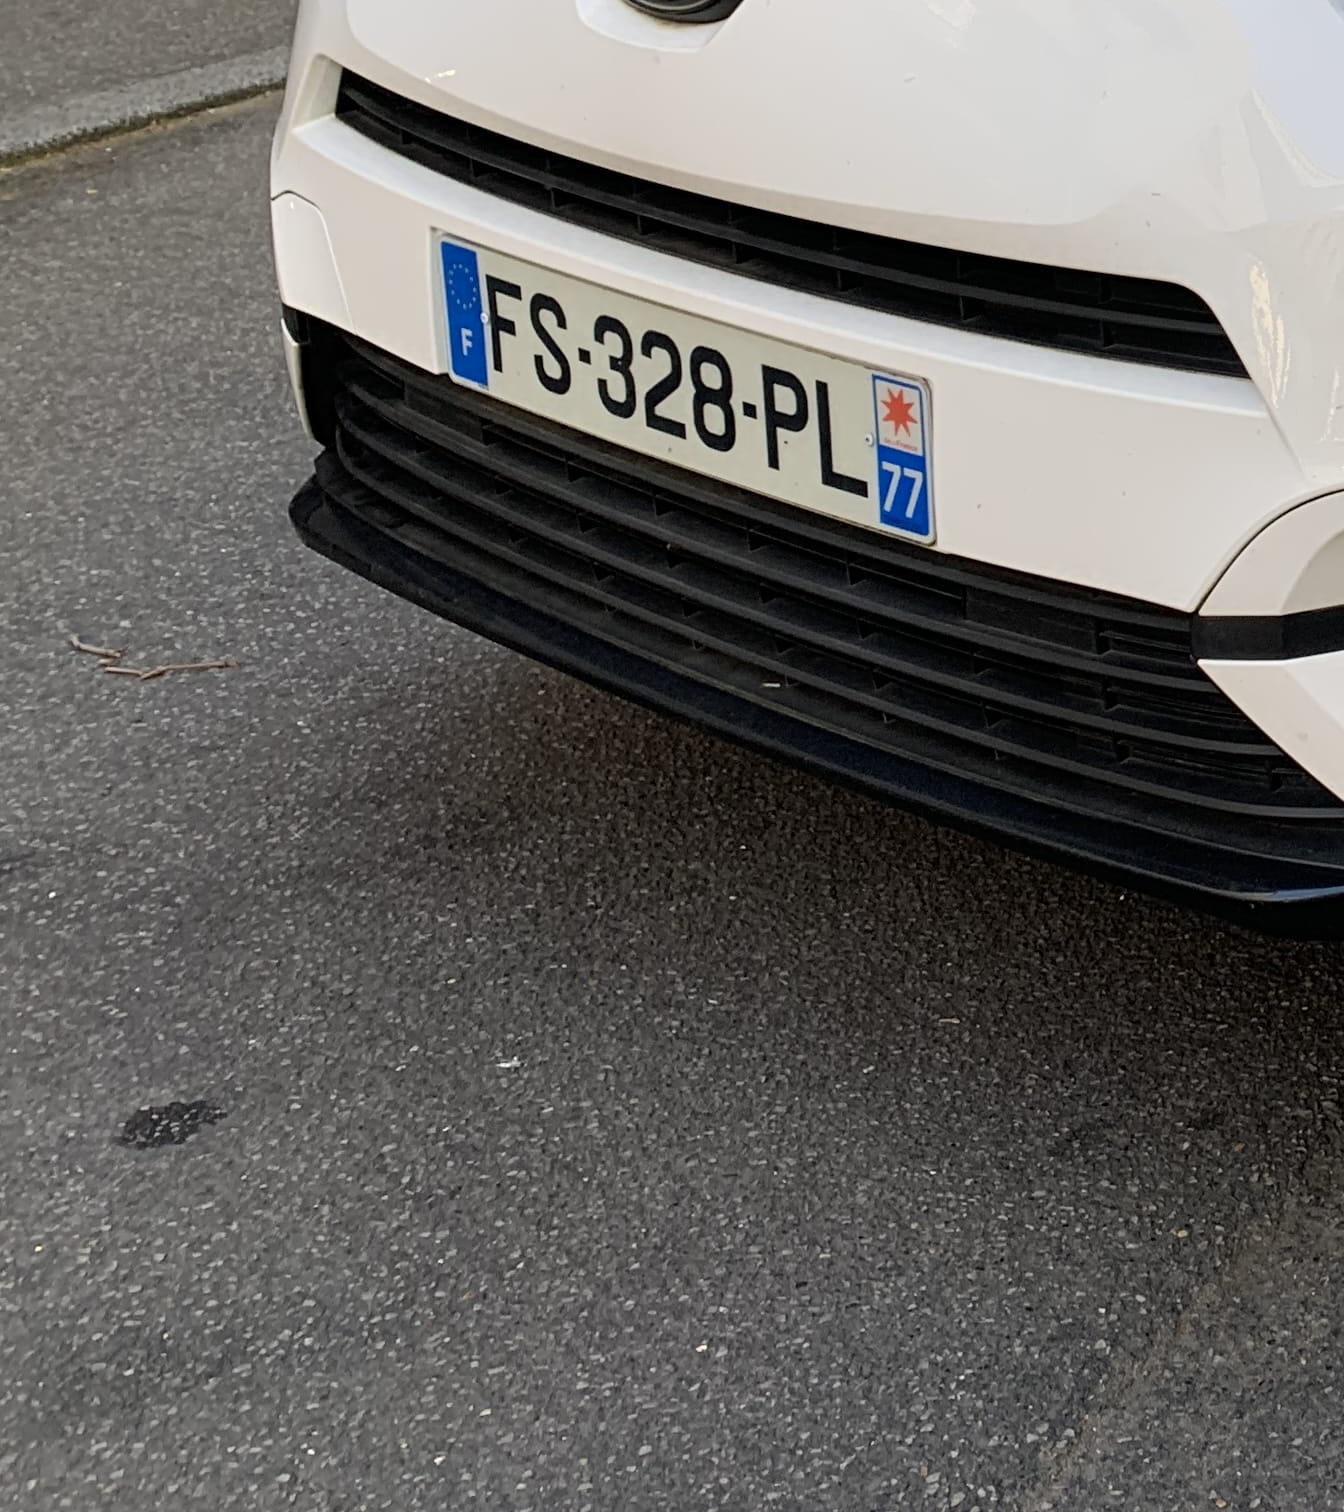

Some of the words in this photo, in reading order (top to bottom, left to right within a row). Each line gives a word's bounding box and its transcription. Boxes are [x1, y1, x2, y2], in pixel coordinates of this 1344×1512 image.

[460, 328, 473, 356] F
[485, 274, 869, 499] FS-328-PL
[881, 460, 924, 519] 77
